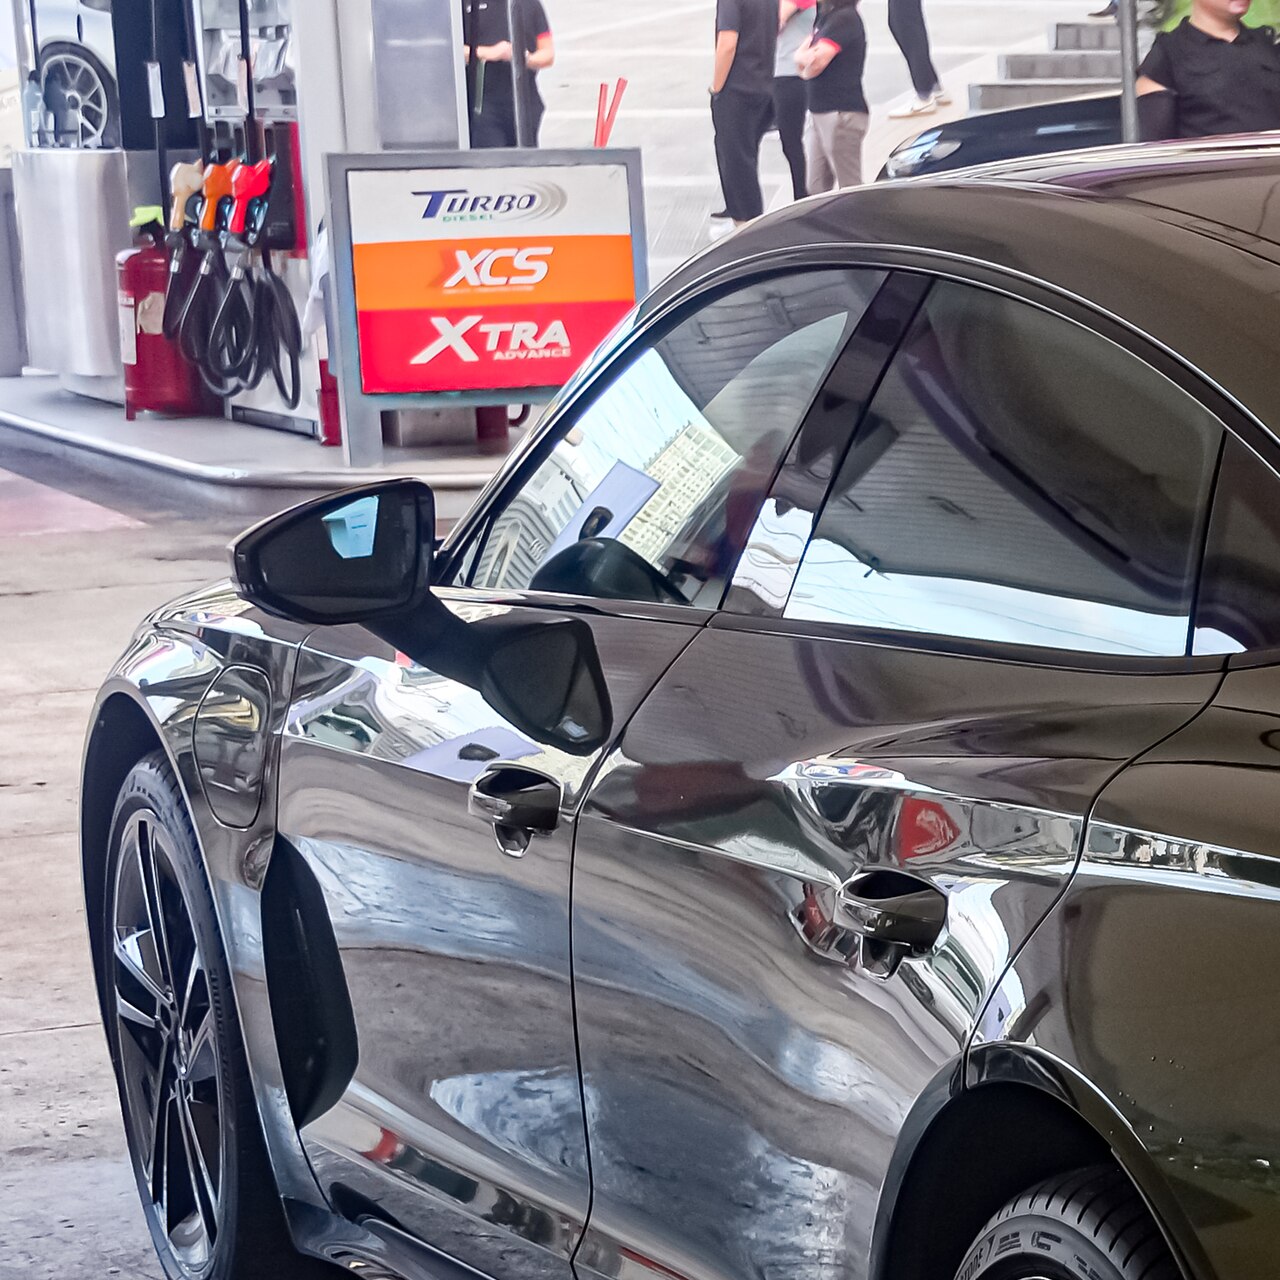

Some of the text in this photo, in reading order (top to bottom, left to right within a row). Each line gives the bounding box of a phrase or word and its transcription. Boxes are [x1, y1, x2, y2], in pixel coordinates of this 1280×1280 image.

[410, 189, 538, 219] TURBO
[442, 213, 494, 223] DIESEL
[443, 246, 554, 288] XCS
[409, 315, 571, 365] XTRA
[493, 347, 572, 361] ADVANCE
